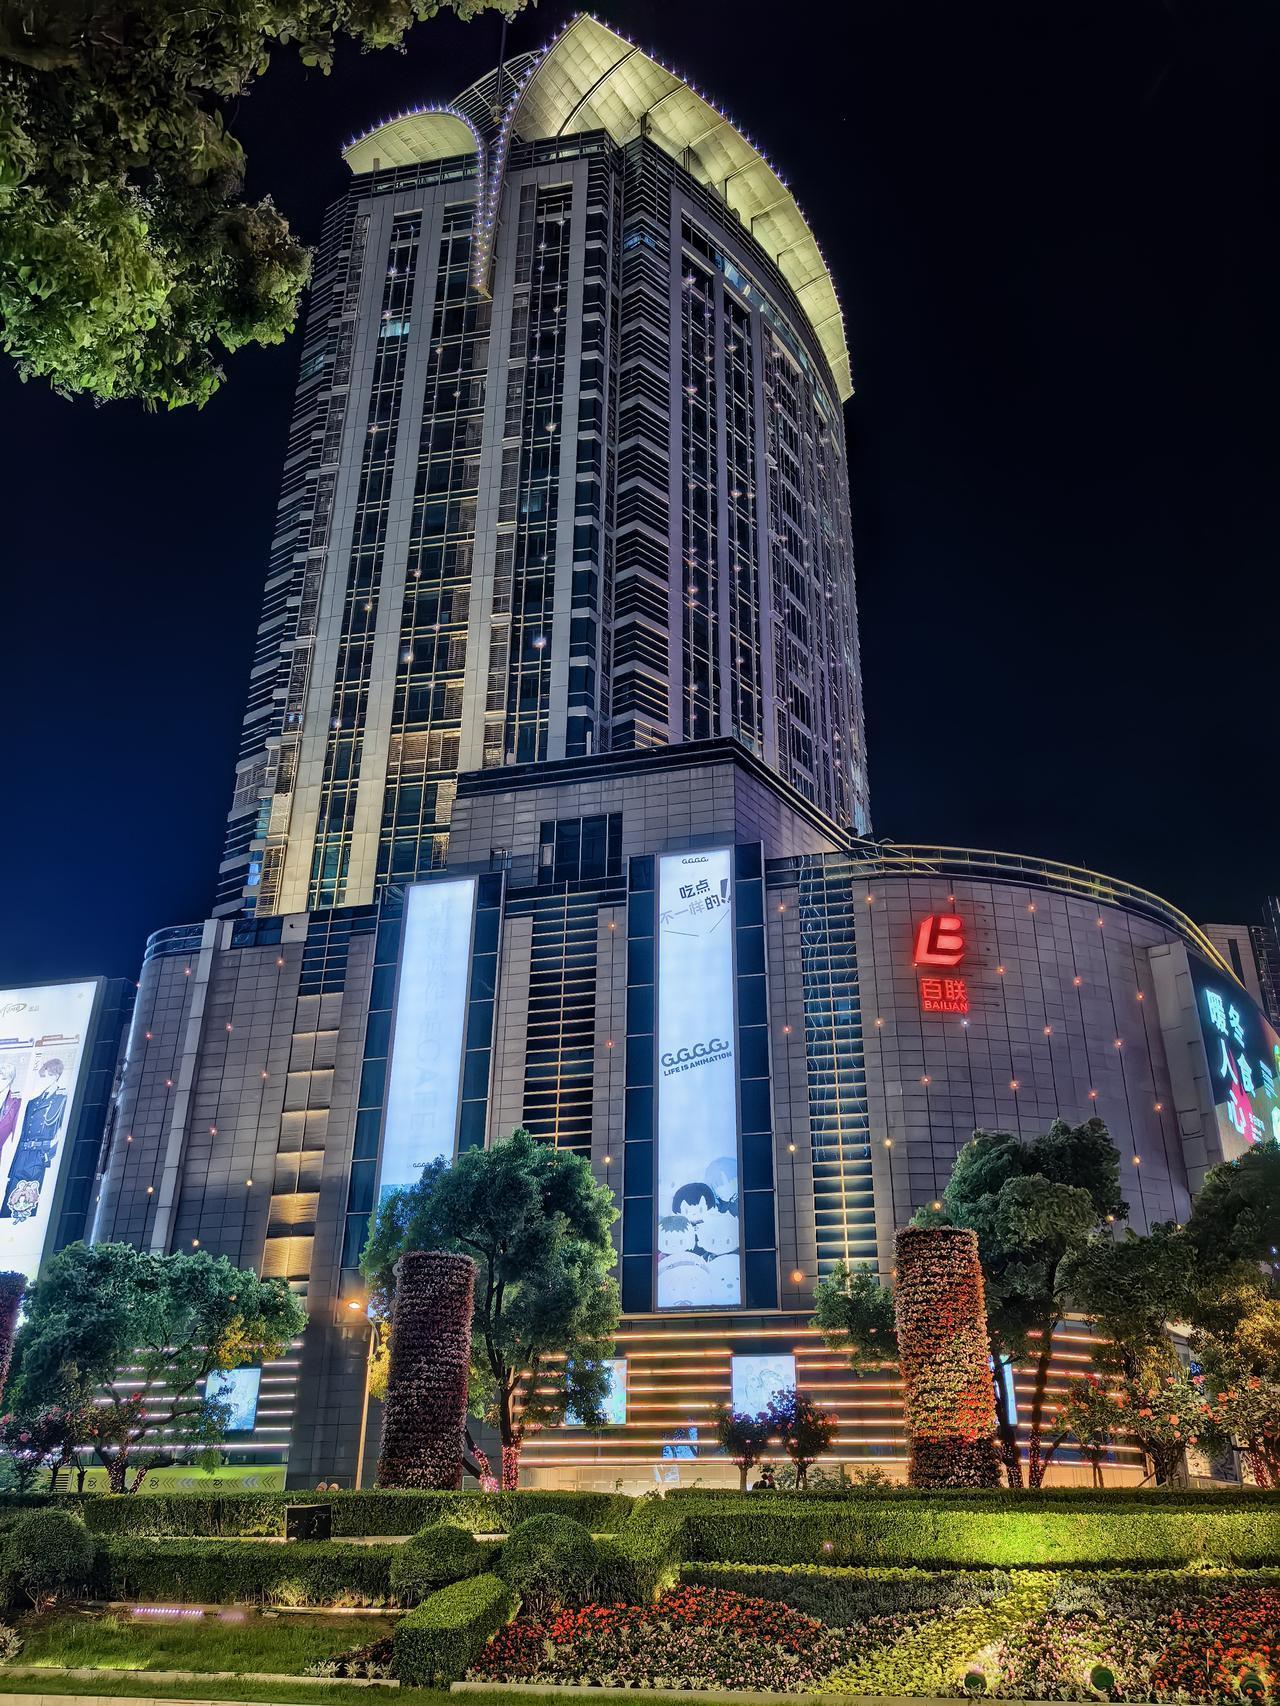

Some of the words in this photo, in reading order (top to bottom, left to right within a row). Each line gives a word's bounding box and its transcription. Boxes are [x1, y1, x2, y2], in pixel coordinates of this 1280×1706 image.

[679, 878, 711, 899] 吃点
[921, 978, 968, 1001] 百联
[924, 1000, 969, 1013] BAILIAN
[663, 1066, 681, 1077] LIFE
[681, 1063, 689, 1071] IS
[690, 1051, 732, 1069] ANIMATION
